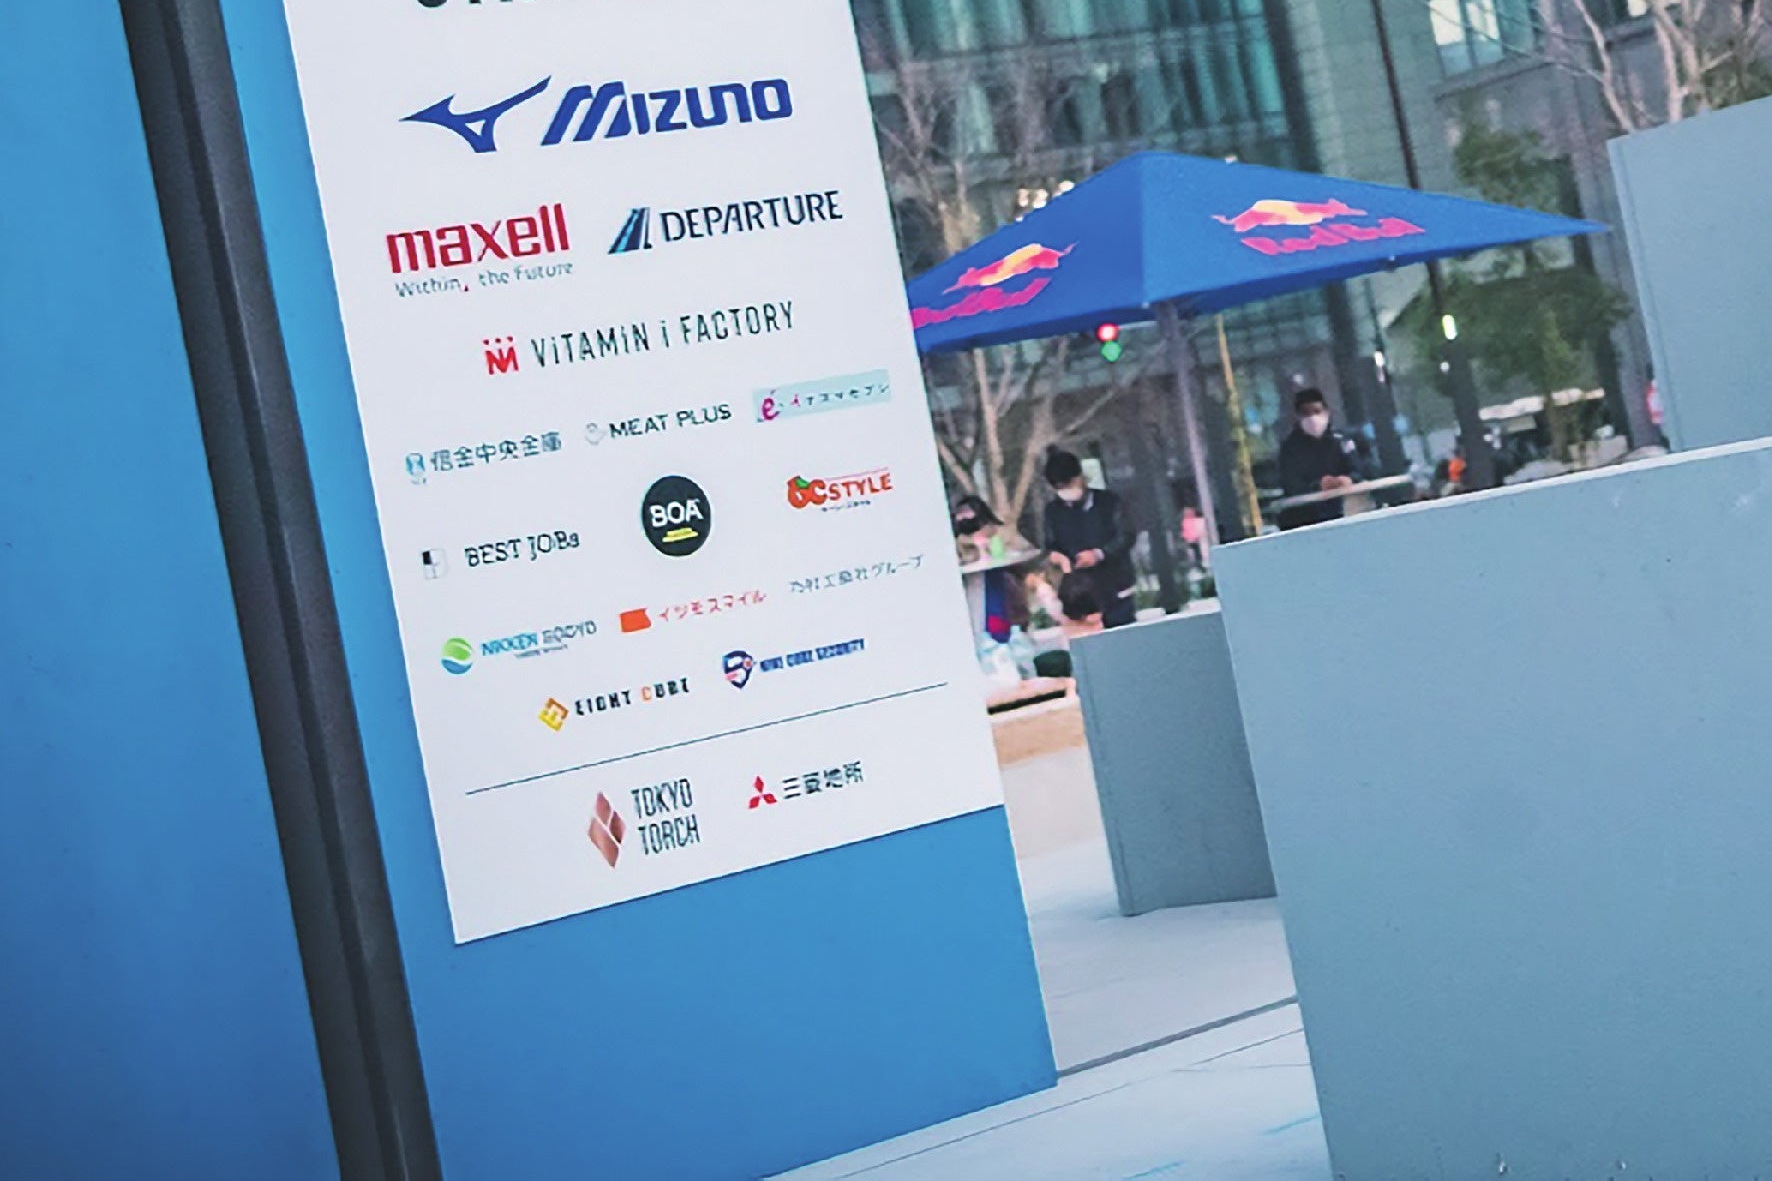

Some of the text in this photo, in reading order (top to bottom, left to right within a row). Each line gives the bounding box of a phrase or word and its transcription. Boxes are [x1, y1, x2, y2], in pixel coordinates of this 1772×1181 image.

[659, 189, 844, 243] DEPARTURE
[386, 203, 570, 274] maxell
[478, 269, 510, 286] the
[679, 300, 794, 345] FACTORY
[608, 403, 733, 439] MEAT PLUS
[429, 431, 562, 472] 信金中央金庫
[649, 498, 704, 529] BOA
[464, 538, 523, 569] BEST
[574, 689, 632, 716] EIGHT
[630, 778, 693, 819] TOKYO
[782, 760, 865, 800] 三菱地所
[637, 813, 701, 856] TORCH
